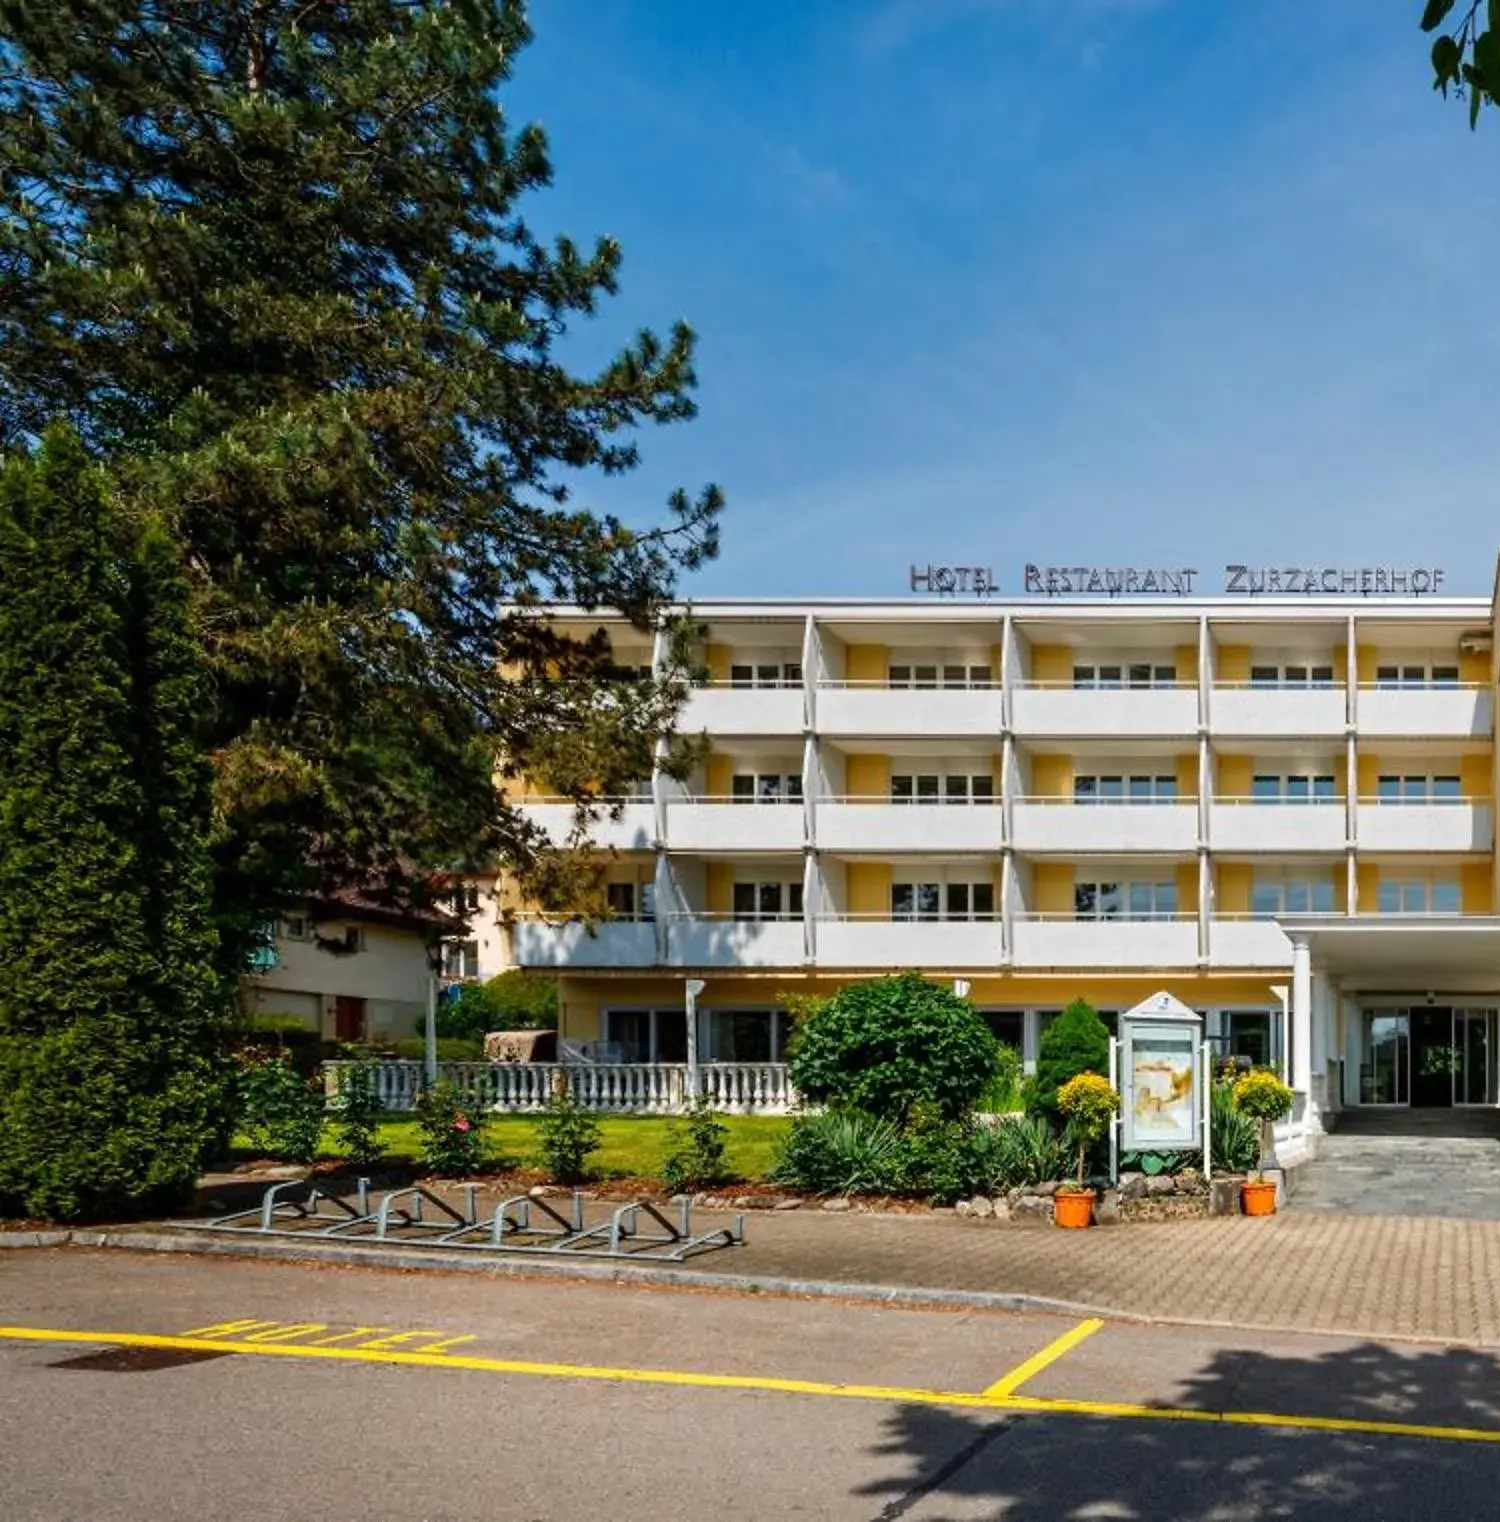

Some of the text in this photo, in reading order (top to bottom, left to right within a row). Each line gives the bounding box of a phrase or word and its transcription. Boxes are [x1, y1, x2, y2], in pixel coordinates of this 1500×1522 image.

[910, 564, 1446, 593] HOTEL RESTAURANT ZURZACHERHOF
[178, 1318, 478, 1353] HOTEL
